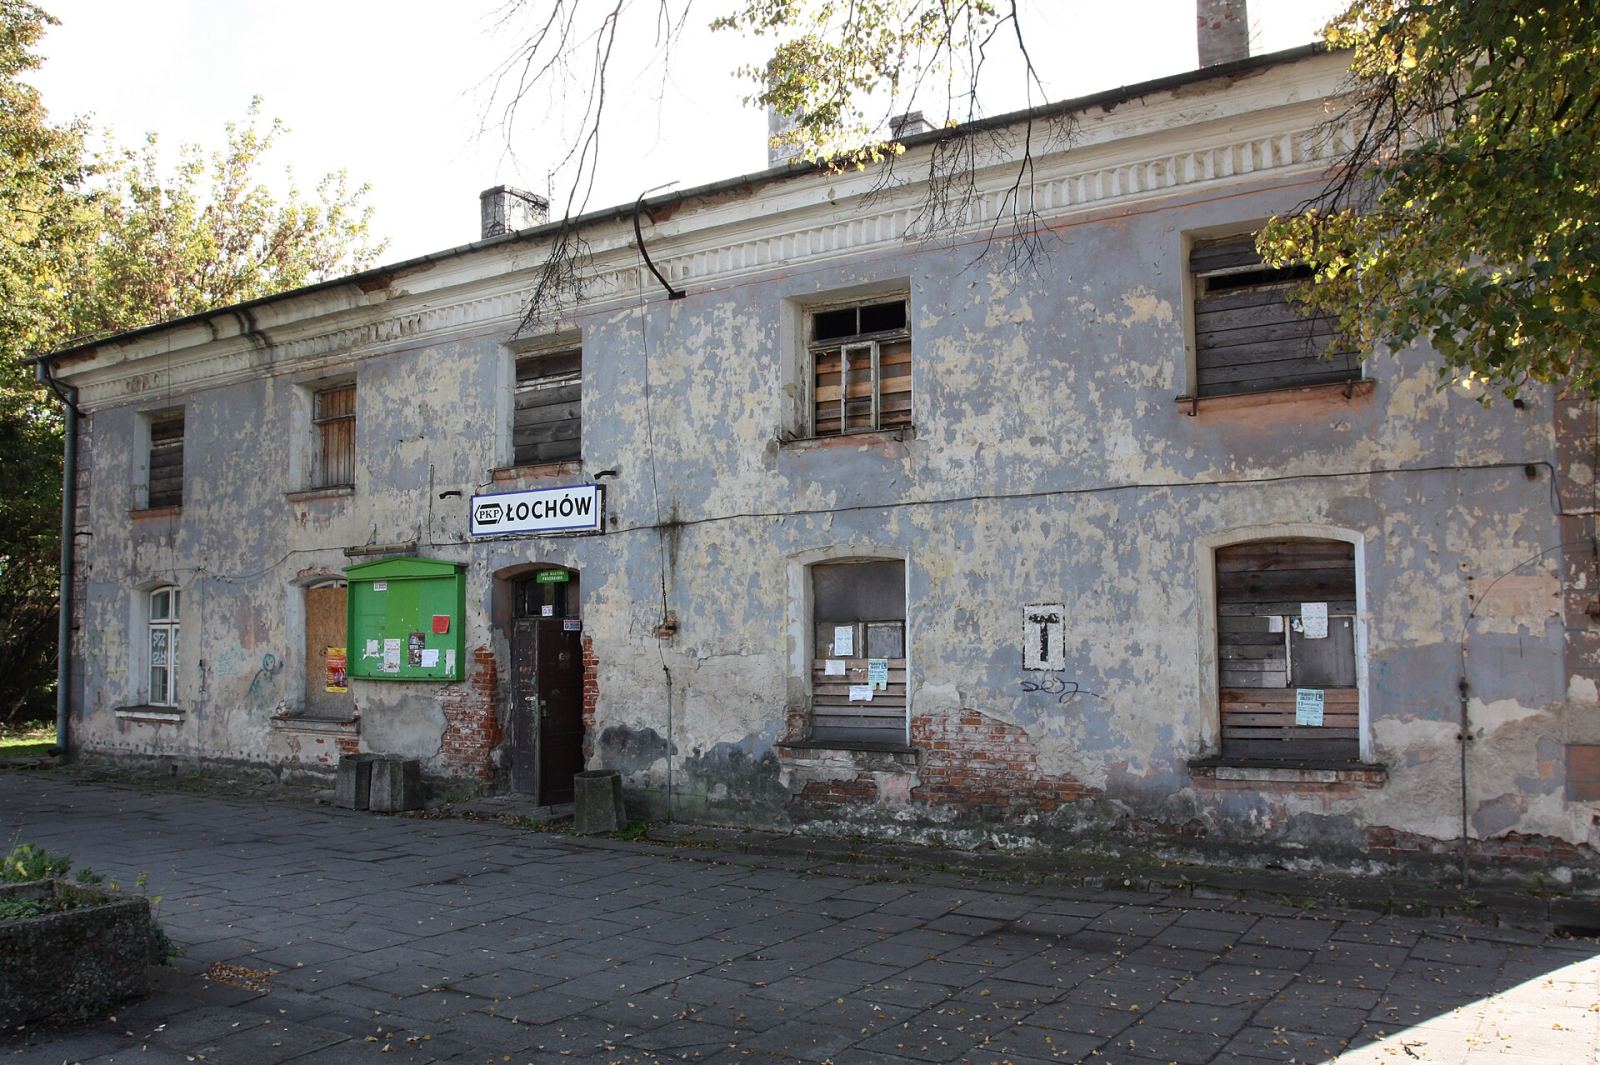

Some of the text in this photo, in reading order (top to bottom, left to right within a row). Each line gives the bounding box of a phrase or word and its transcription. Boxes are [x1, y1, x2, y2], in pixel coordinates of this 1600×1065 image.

[479, 509, 500, 519] PKP
[506, 493, 592, 521] ŁOCHÓW
[1028, 613, 1060, 662] T
